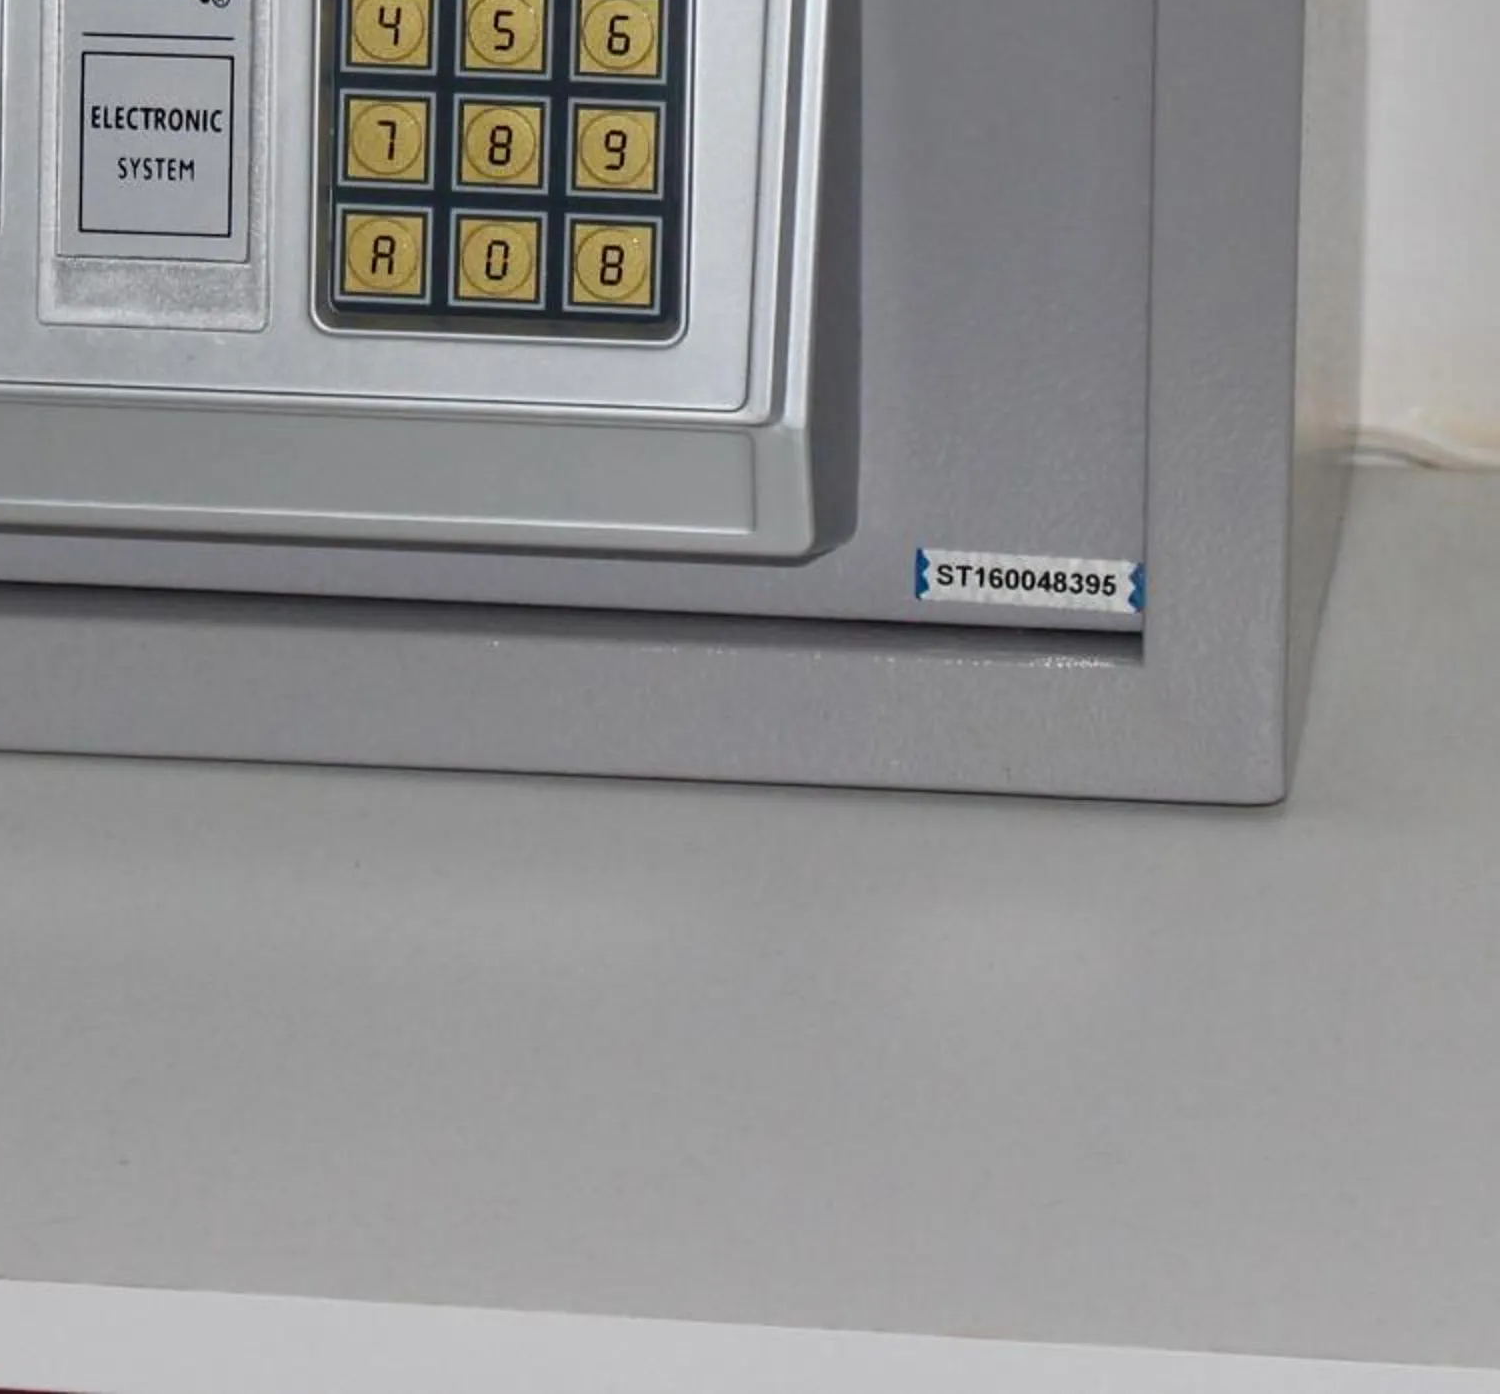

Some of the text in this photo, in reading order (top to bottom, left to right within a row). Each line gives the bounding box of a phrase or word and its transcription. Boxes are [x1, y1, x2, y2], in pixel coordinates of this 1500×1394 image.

[378, 7, 401, 46] 4
[493, 10, 516, 51] 5
[606, 15, 631, 56] 6
[90, 105, 223, 133] ELECTRONIC
[377, 120, 397, 161] 7
[488, 125, 513, 166] 8
[603, 129, 628, 171] 9
[117, 156, 195, 181] SYSTEM
[371, 235, 396, 275] A
[936, 564, 1117, 597] ST160048395
